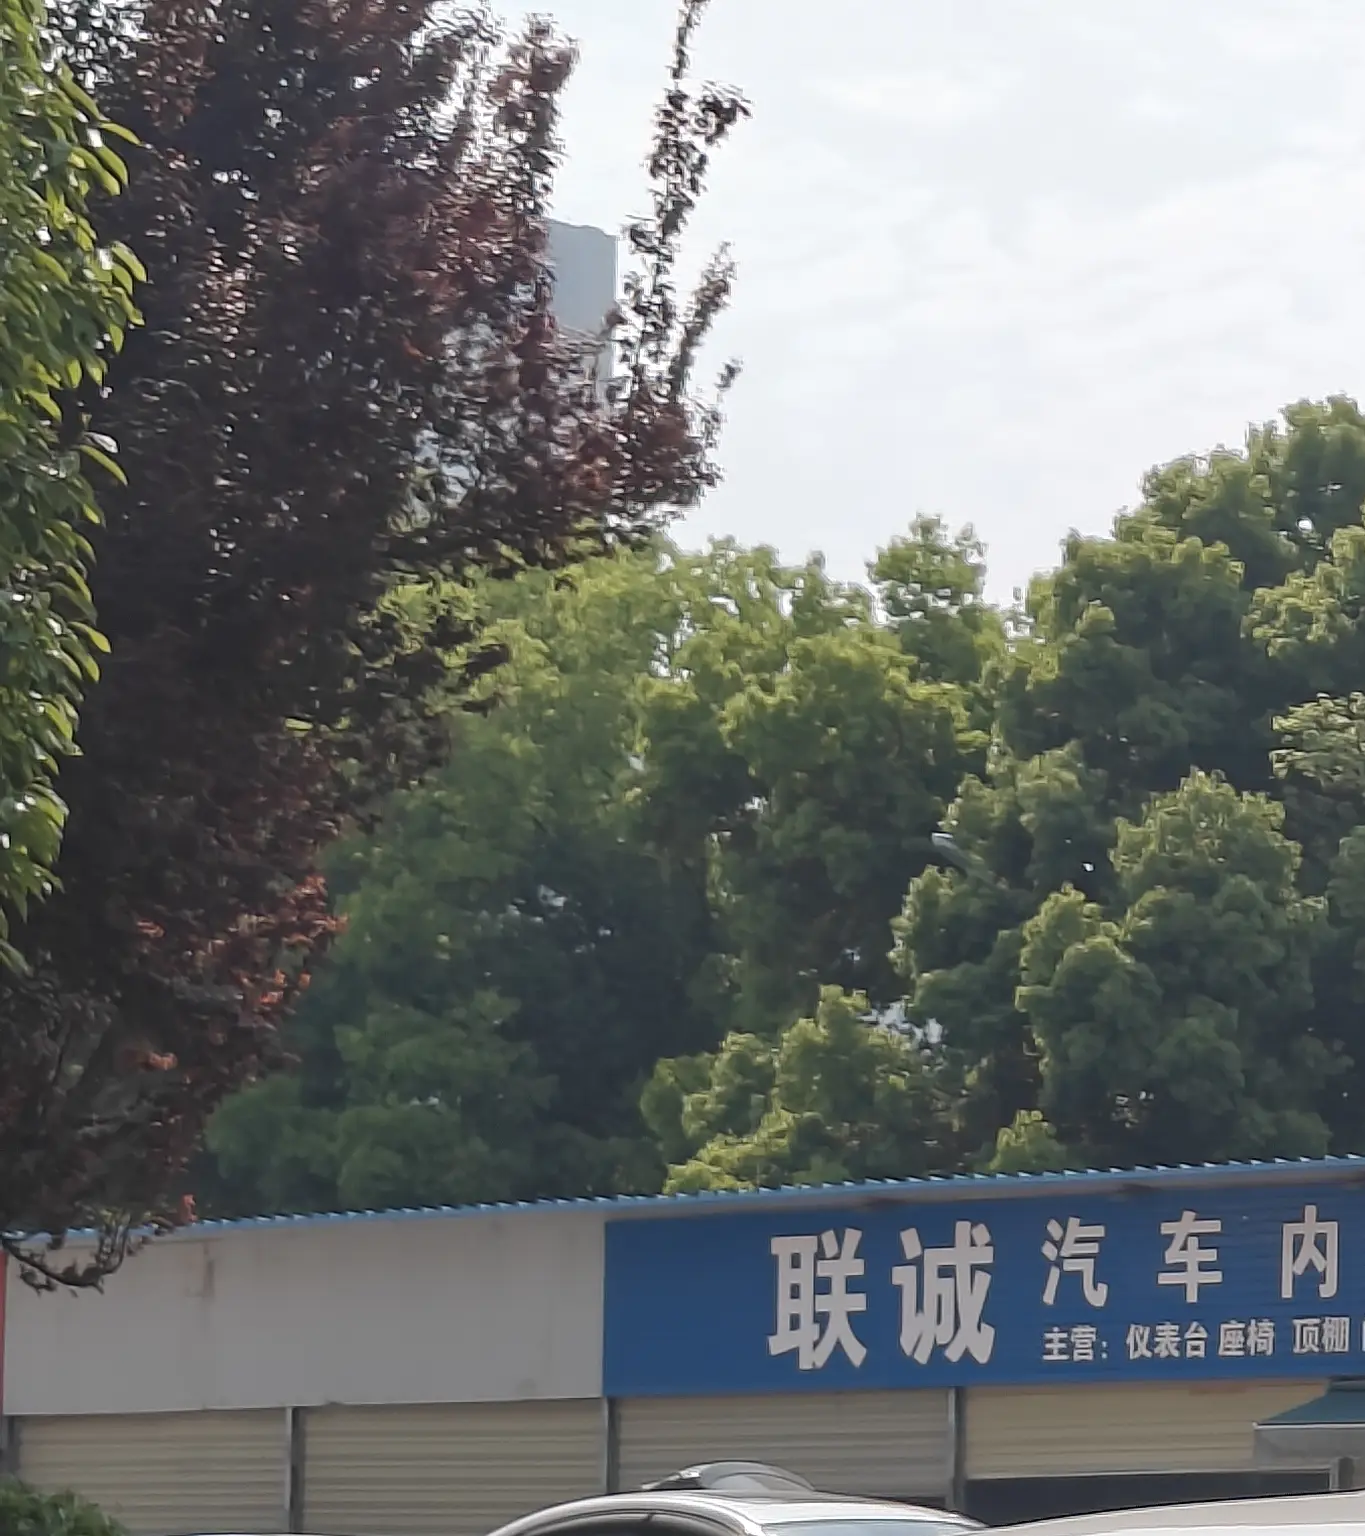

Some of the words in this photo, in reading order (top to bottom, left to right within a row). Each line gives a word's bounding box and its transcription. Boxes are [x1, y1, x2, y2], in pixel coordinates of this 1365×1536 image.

[768, 1220, 996, 1370] 联诚
[1217, 1317, 1275, 1357] 座椅
[1291, 1315, 1350, 1354] 顶棚
